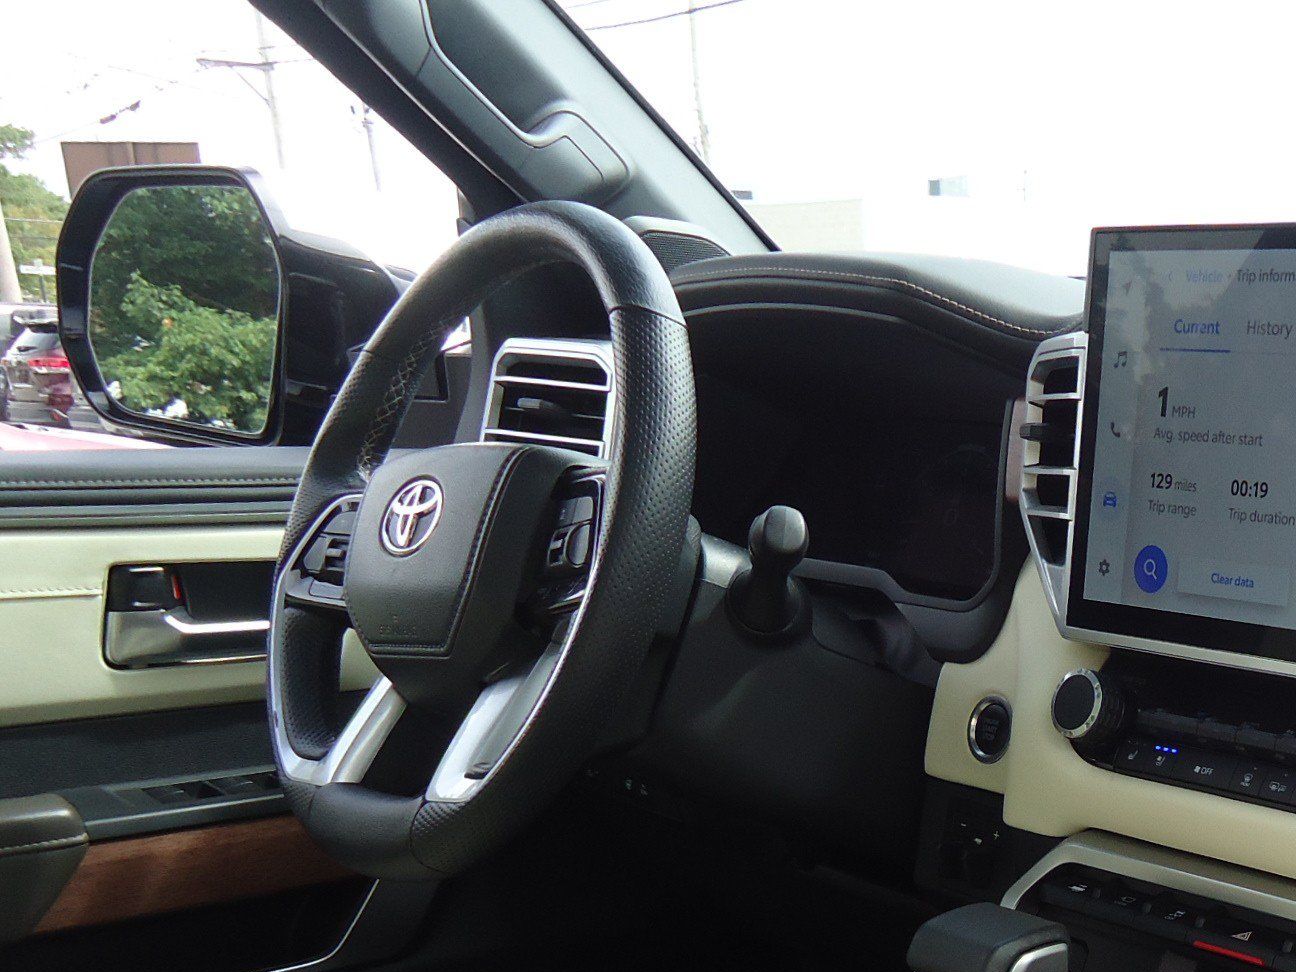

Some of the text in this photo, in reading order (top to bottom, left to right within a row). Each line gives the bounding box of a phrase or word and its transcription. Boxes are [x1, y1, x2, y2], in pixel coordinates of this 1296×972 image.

[1186, 269, 1223, 283] Vehicle
[1236, 269, 1256, 285] Trip
[1173, 319, 1221, 335] Current
[1246, 320, 1294, 339] History
[1157, 386, 1196, 418] 1 MPH
[1177, 430, 1210, 447] speed
[1211, 431, 1237, 446] after
[1238, 433, 1263, 447] start
[1150, 472, 1197, 493] 129 miles
[1230, 479, 1269, 499] 00:19
[1147, 498, 1197, 517] Trip range
[1227, 507, 1296, 526] Trip duration
[1210, 572, 1255, 588] Clear data
[1200, 766, 1214, 776] OFF
